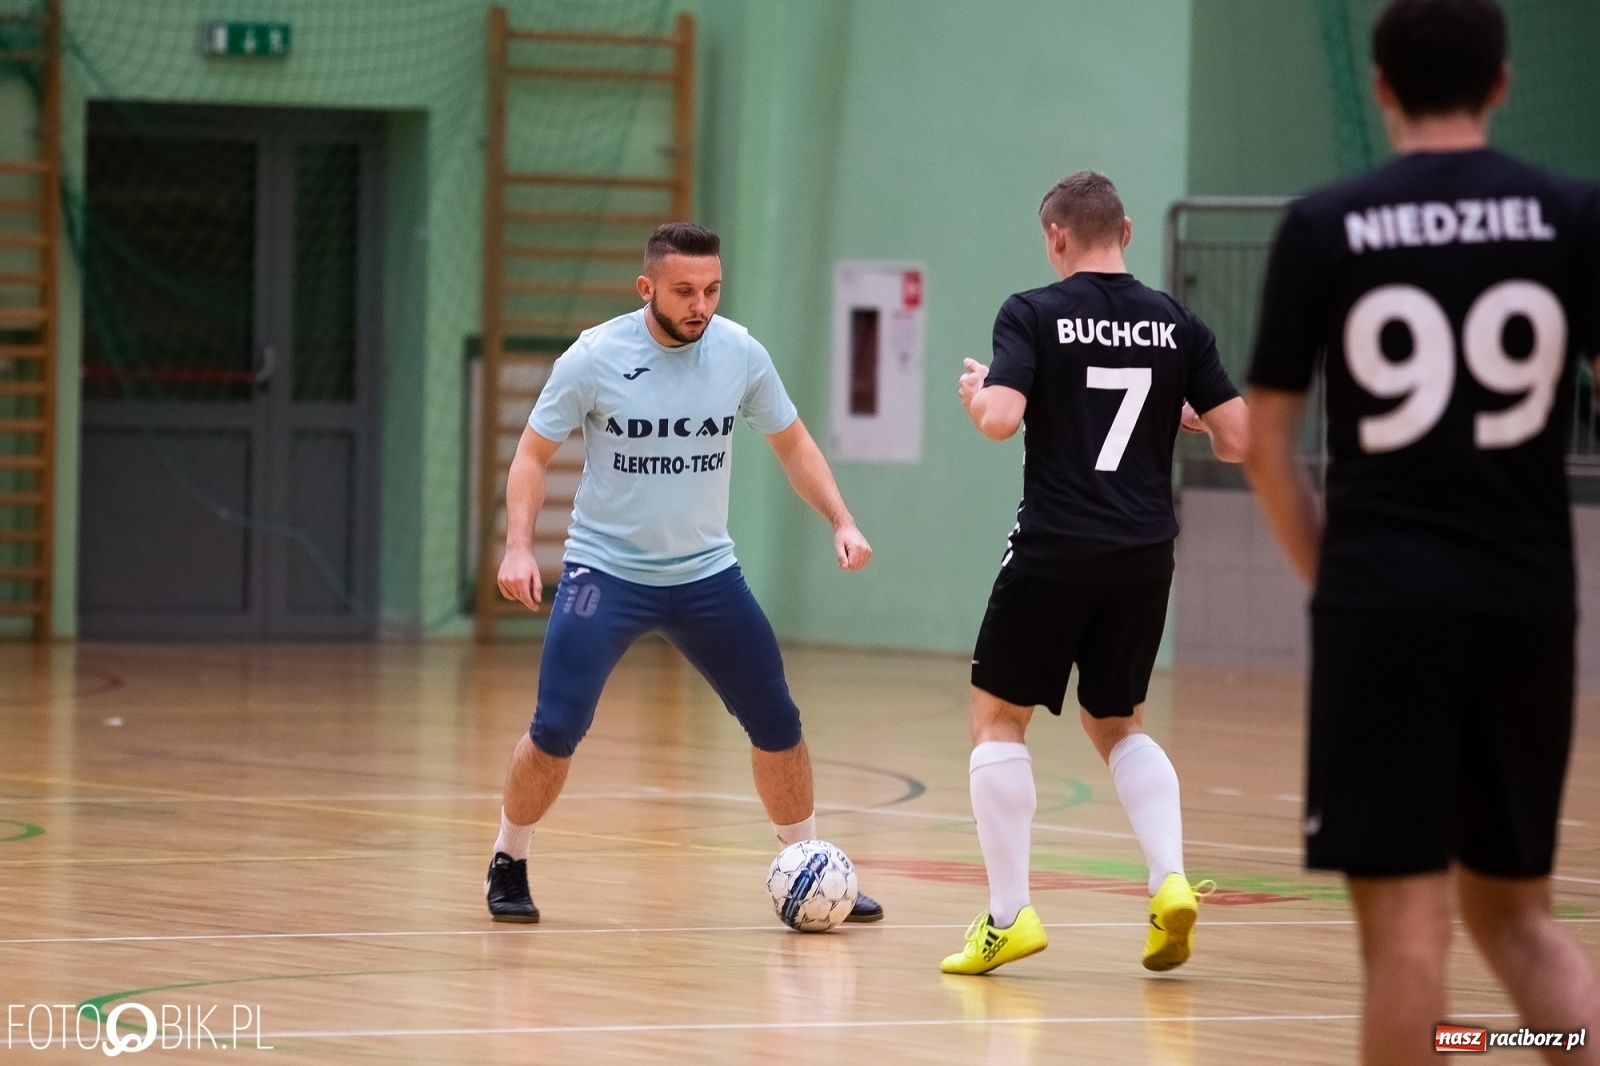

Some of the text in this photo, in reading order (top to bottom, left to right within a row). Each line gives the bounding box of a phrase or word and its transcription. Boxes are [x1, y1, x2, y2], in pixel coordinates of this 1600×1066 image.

[1344, 196, 1556, 253] NIEDZIEL
[1056, 318, 1177, 349] BUCHCIK
[1343, 278, 1568, 454] 99
[1086, 366, 1152, 471] 7
[613, 451, 726, 475] ELEKTRO-TECH
